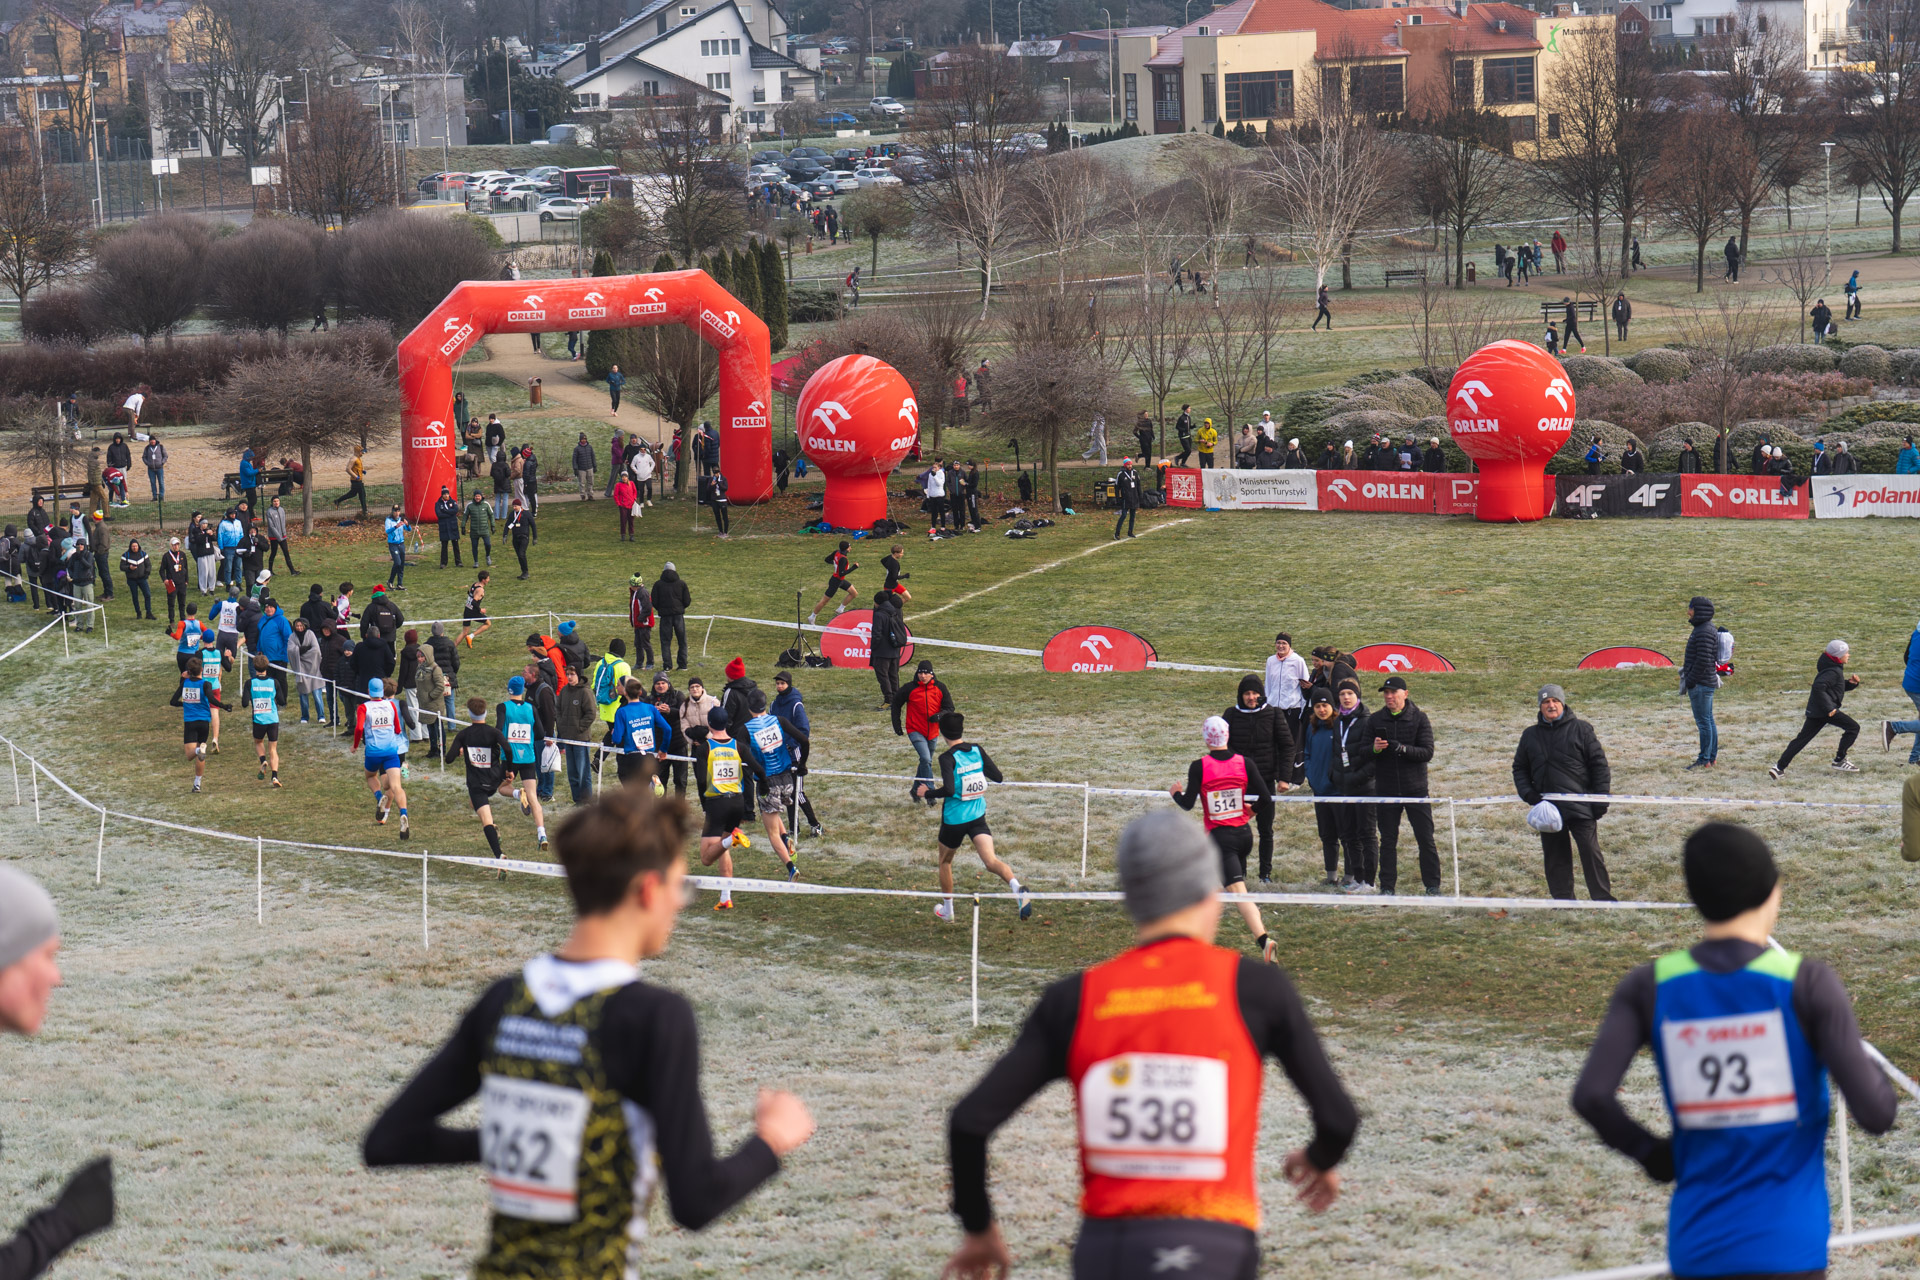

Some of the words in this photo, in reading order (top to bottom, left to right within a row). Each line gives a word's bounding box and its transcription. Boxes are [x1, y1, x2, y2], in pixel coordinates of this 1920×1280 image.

[570, 308, 604, 318] ORLEN
[631, 304, 665, 314] ORLEN
[509, 312, 543, 320] ORLEN
[704, 312, 733, 337] ORLEN
[443, 326, 472, 354] ORLEN
[734, 418, 765, 426] ORLEN
[1454, 418, 1499, 433] ORLEN
[1537, 417, 1574, 431] ORLEN
[413, 438, 445, 447] ORLEN
[808, 436, 856, 452] ORLEN
[890, 433, 917, 451] ORLE
[1239, 478, 1290, 486] Ministerstwo
[1240, 487, 1266, 497] Sportu
[1267, 487, 1271, 495] i
[1273, 487, 1307, 497] Turystyki
[1362, 482, 1425, 500] ORLEN
[1565, 484, 1606, 507] 4F
[1628, 483, 1671, 507] 4F
[1729, 487, 1799, 506] ORLEN
[843, 647, 872, 658] ORLE
[1071, 662, 1114, 673] ORLEN
[184, 692, 197, 700] 533
[374, 716, 389, 725] 618
[511, 730, 526, 738] 612
[638, 734, 652, 745] 424
[760, 732, 778, 747] 254
[717, 767, 734, 777] 435
[966, 780, 984, 793] 408
[1214, 798, 1237, 813] 514
[1698, 1052, 1752, 1098] 93
[1107, 1096, 1198, 1144] 538
